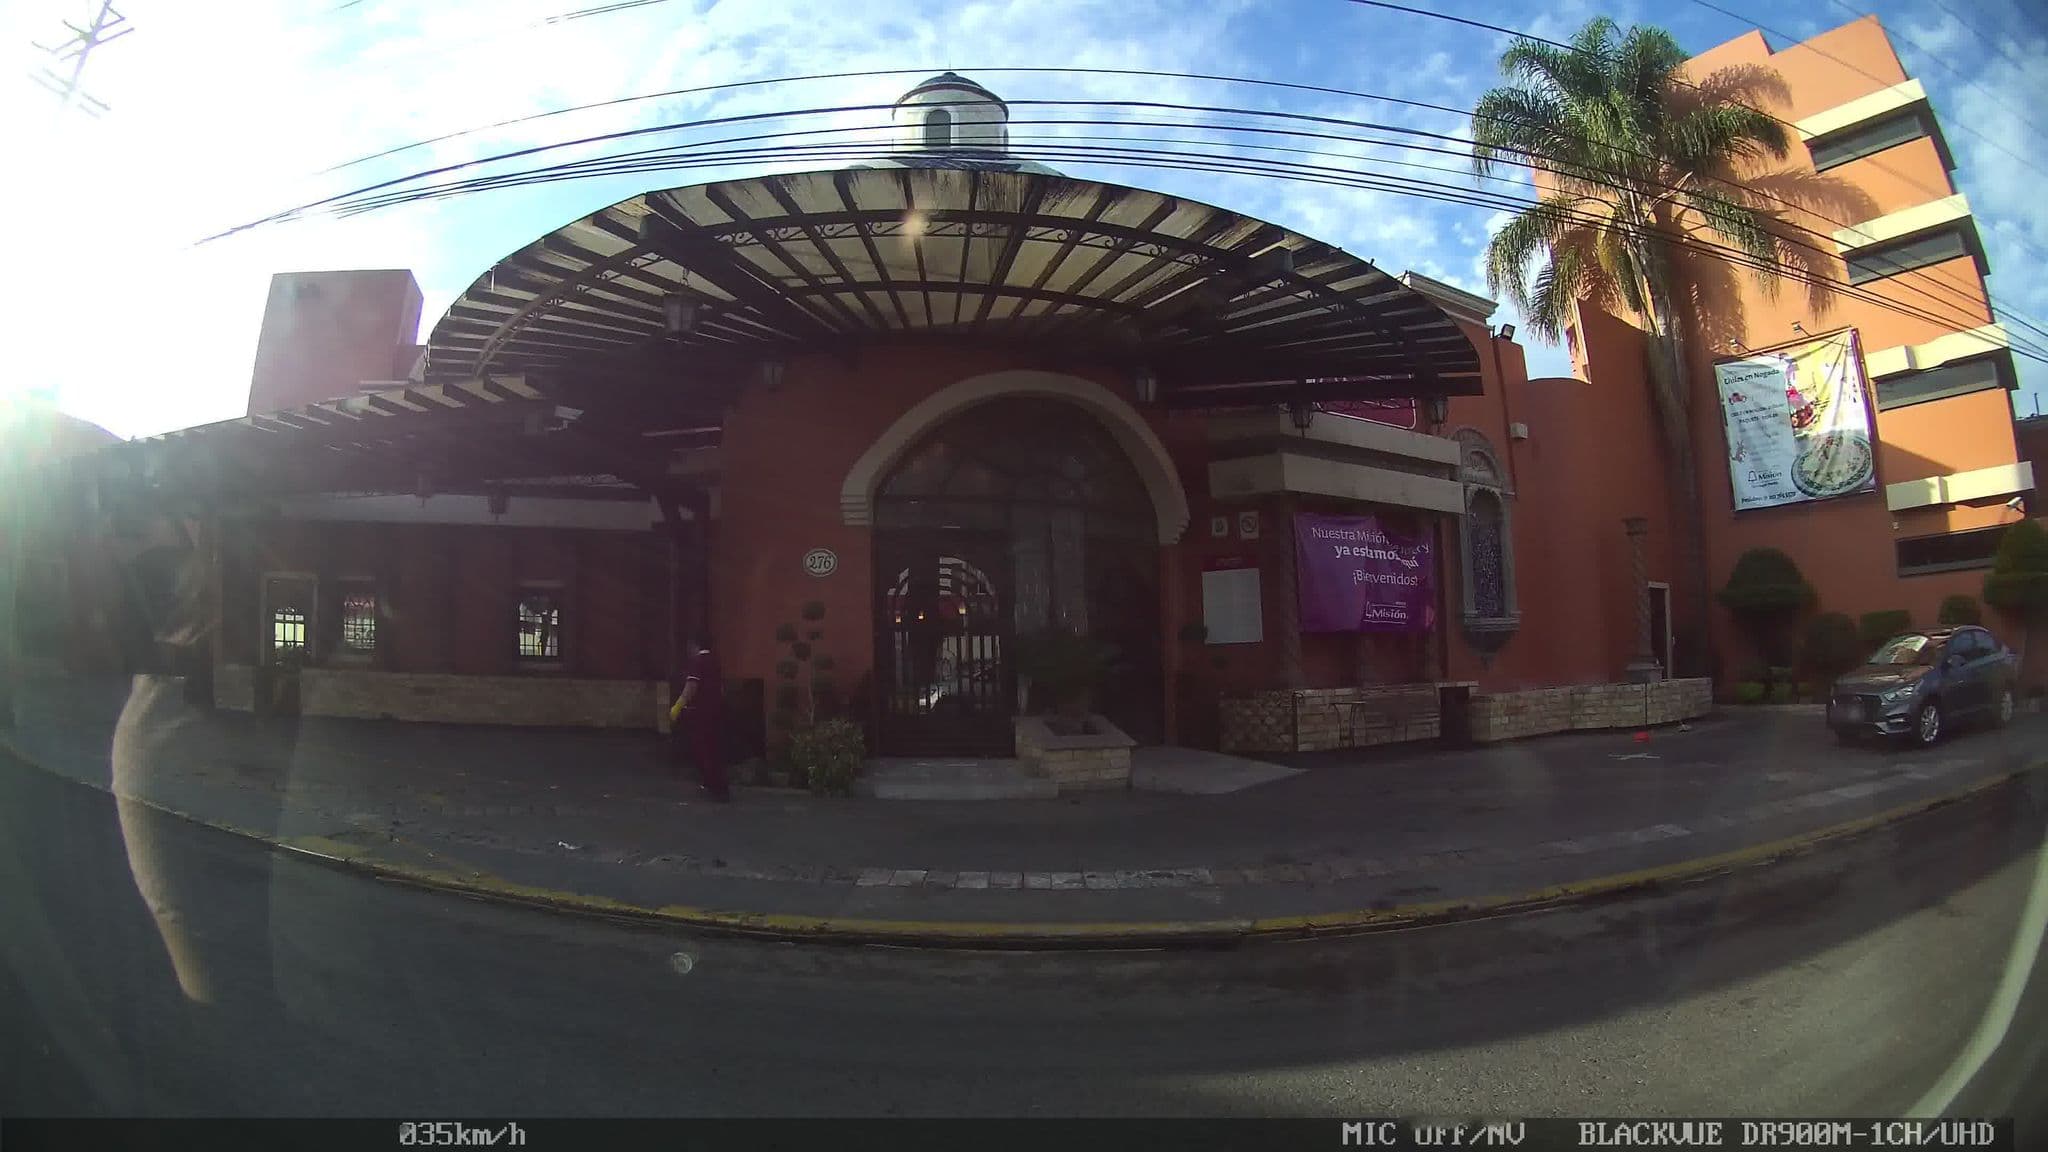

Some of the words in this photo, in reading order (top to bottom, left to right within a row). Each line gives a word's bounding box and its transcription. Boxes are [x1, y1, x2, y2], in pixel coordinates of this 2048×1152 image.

[1312, 527, 1355, 541] Nuestra
[1357, 530, 1388, 544] Miión
[809, 555, 832, 570] 276
[1334, 545, 1351, 559] ya
[1400, 556, 1419, 569] quí
[1353, 569, 1418, 587] ¡Bievenidos!
[1372, 607, 1406, 619] Misión
